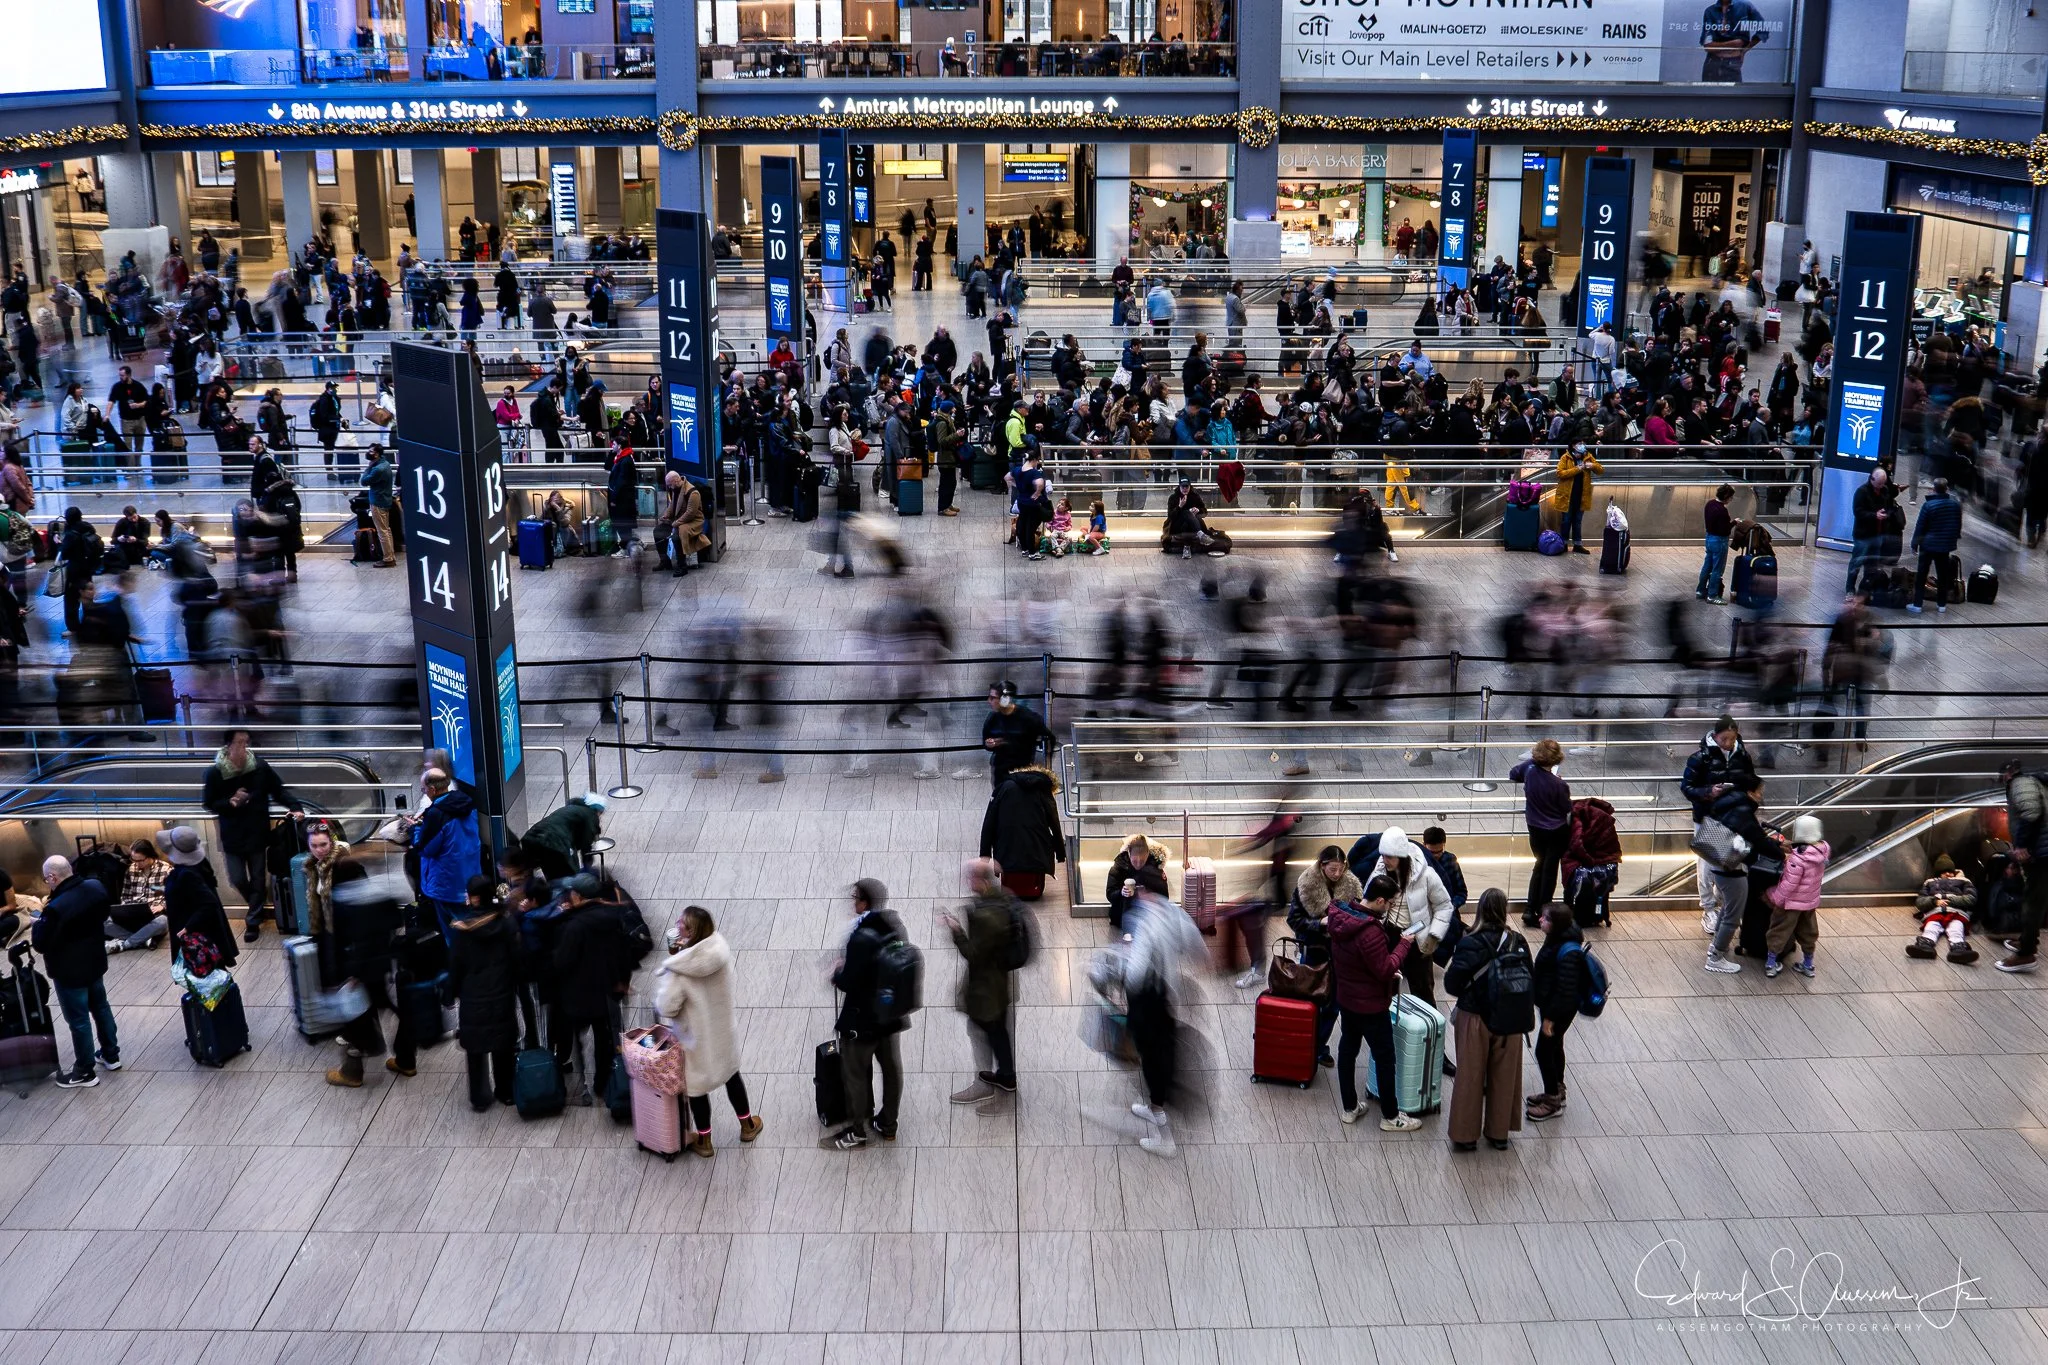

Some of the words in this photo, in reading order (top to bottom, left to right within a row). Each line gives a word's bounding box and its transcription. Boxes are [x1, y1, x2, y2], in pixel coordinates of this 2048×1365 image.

[1298, 15, 1330, 36] citi
[1349, 30, 1385, 41] lovepop
[1400, 24, 1487, 35] (MALIN+GOETZ)
[1510, 26, 1584, 35] MOLESKINE
[1602, 24, 1647, 40] RAINS
[1668, 22, 1688, 32] rag
[1705, 22, 1731, 32] bone
[1298, 48, 1336, 66] Visit
[1342, 50, 1374, 66] Our
[1380, 50, 1420, 66] Main
[1426, 50, 1470, 67] Level
[1477, 50, 1549, 68] Retailers
[291, 102, 320, 120] 8th
[324, 102, 387, 120] Avenue
[391, 102, 405, 120] &
[409, 101, 446, 119] 31st
[450, 100, 504, 118] Street
[843, 97, 909, 114] Amtrak
[913, 96, 1025, 117] Metropolitan
[1030, 96, 1094, 116] Lounge
[1490, 98, 1527, 116] 31st
[1531, 99, 1584, 116] Street
[1902, 115, 1957, 133] AMTRAK
[827, 162, 836, 179] 7
[857, 164, 864, 178] 6
[1325, 154, 1389, 168] BAKERY
[1452, 163, 1462, 180] 7
[827, 190, 836, 207] 8
[1451, 190, 1461, 206] 8
[1693, 192, 1720, 204] COLD
[1934, 190, 1950, 200] Amtrak
[1951, 192, 1971, 206] Ticketing
[1972, 197, 1981, 205] and
[1982, 197, 2002, 211] Baggage
[2003, 201, 2026, 213] Check-in
[771, 202, 782, 224] 9
[1599, 204, 1612, 224] 9
[770, 239, 787, 261] 10
[1593, 240, 1615, 261] 10
[668, 278, 688, 309] 11
[1860, 279, 1886, 310] 11
[668, 330, 691, 361] 12
[1851, 330, 1886, 361] 12
[414, 465, 446, 519] 13
[485, 462, 503, 519] 13
[419, 555, 455, 612] 14
[491, 551, 509, 611] 14
[429, 661, 464, 682] MOYNIHAN
[429, 671, 449, 686] TRAIN
[450, 679, 466, 693] HALL
